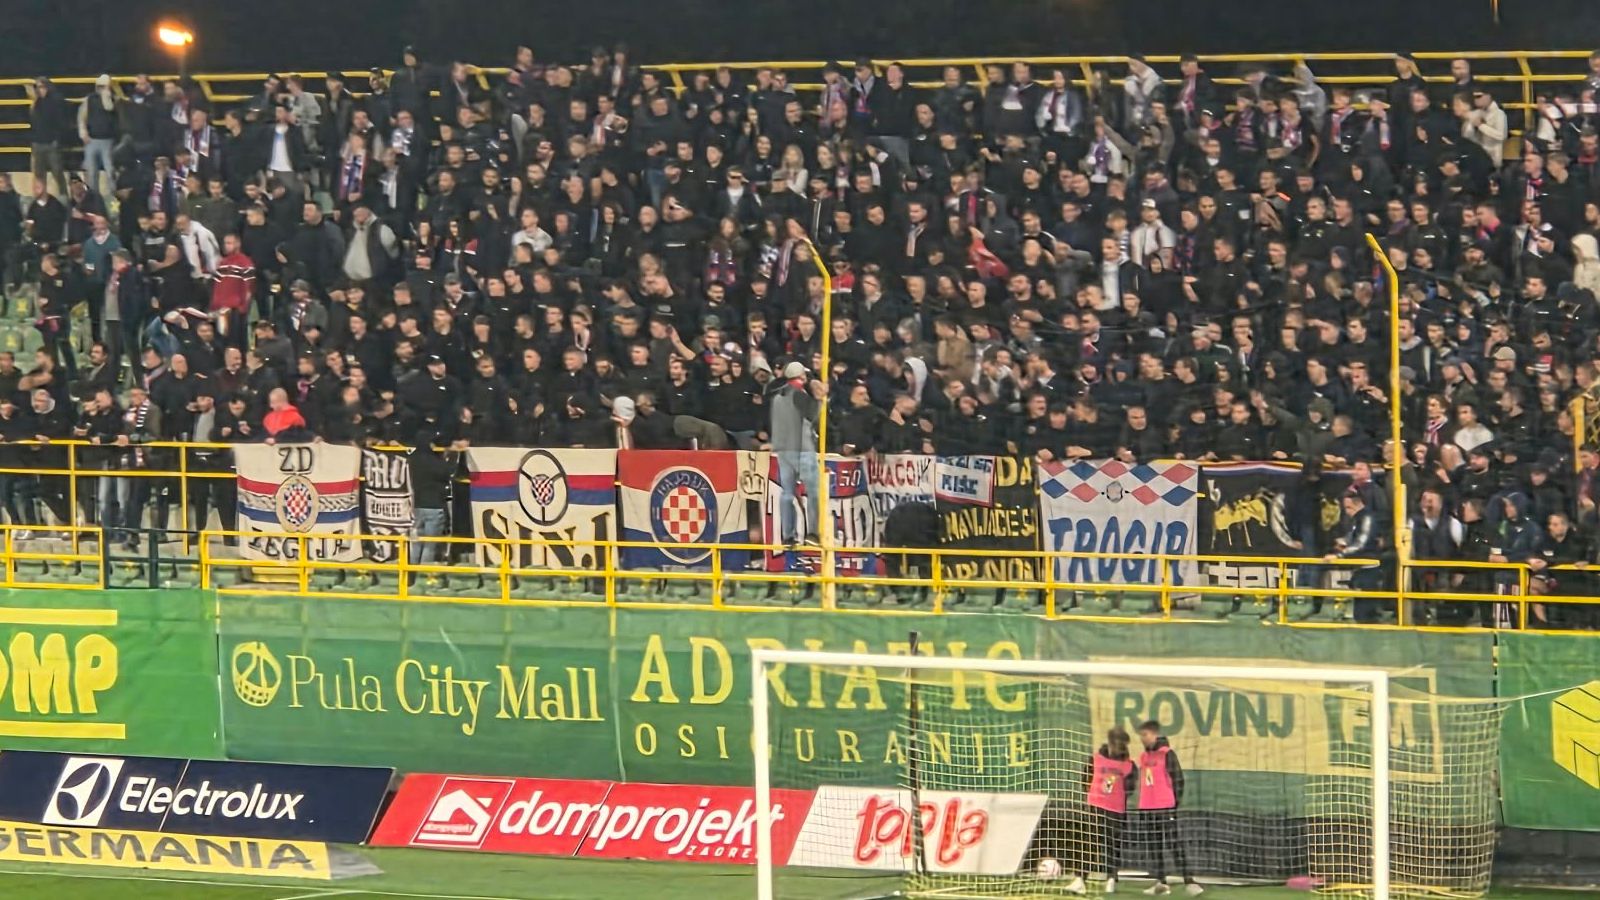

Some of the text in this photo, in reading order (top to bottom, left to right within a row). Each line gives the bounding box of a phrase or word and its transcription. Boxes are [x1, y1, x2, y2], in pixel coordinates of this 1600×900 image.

[1048, 516, 1188, 586] TROGIR
[0, 631, 118, 714] MP
[286, 654, 605, 736] Pula City Mall
[630, 634, 1027, 713] ADRIATIC
[1114, 690, 1296, 739] ROVINJ
[119, 776, 305, 820] Electrolux
[498, 790, 785, 855] domprojekt
[685, 845, 757, 859] ZAGRE
